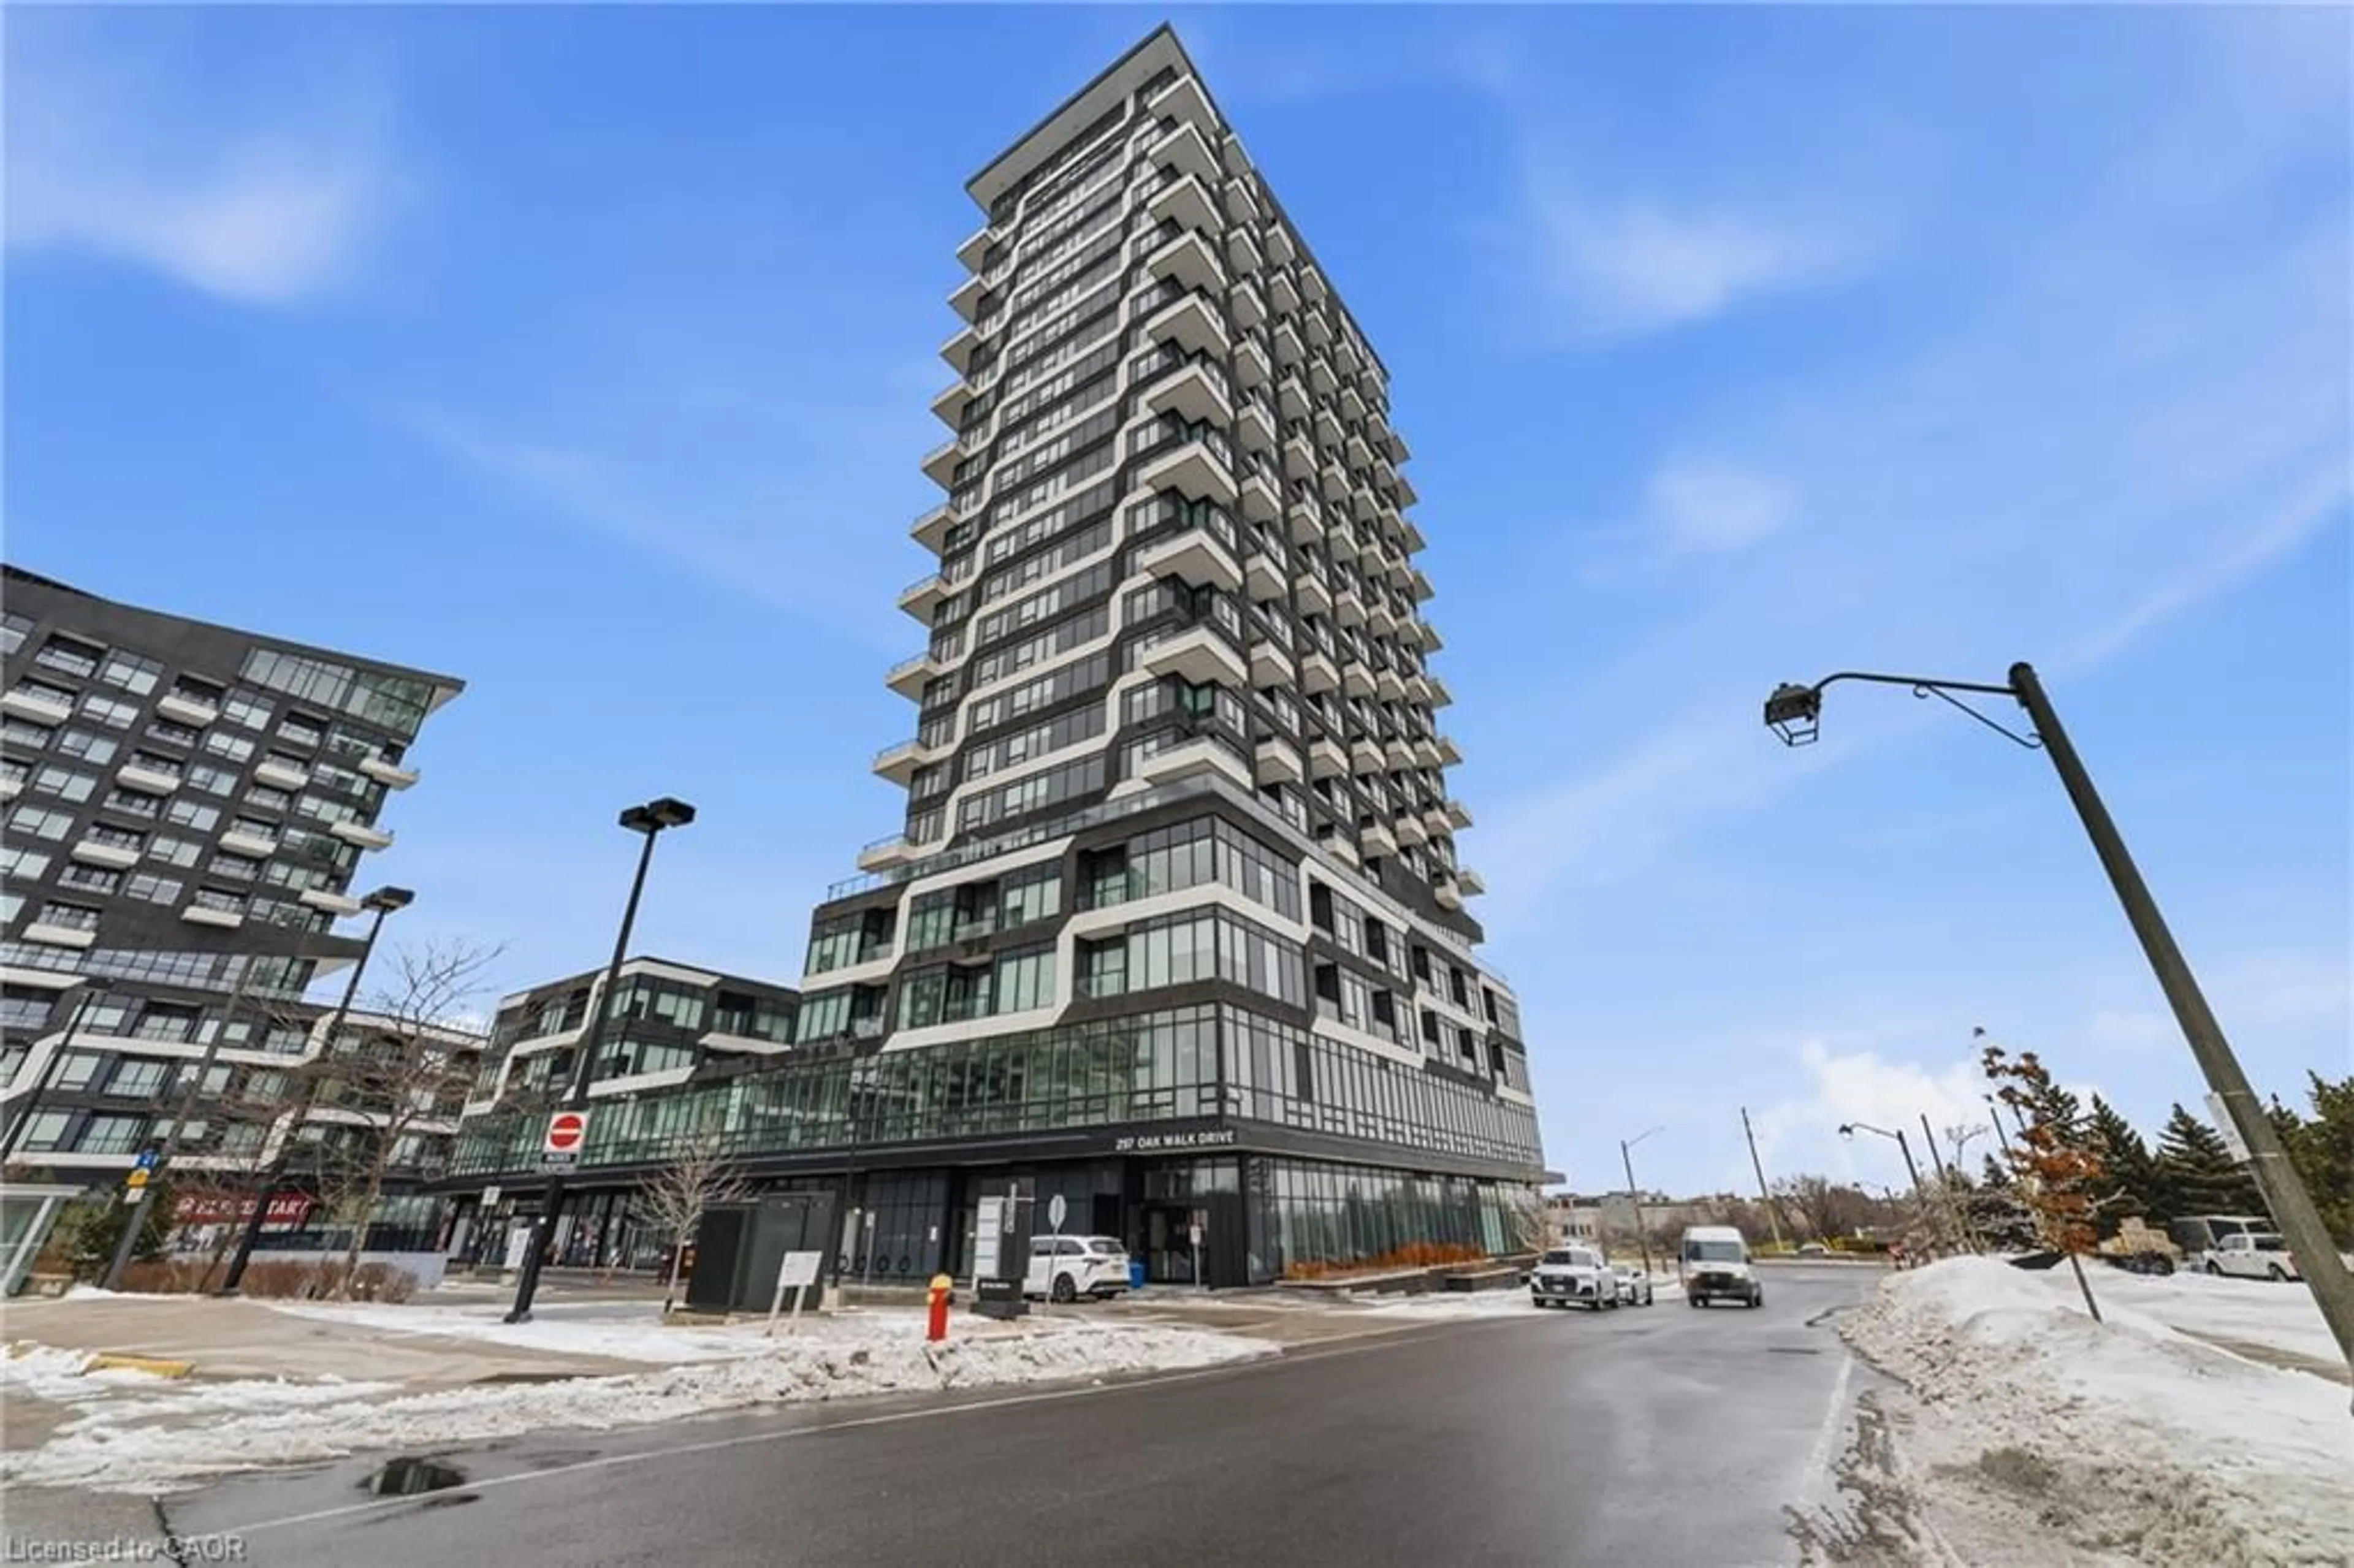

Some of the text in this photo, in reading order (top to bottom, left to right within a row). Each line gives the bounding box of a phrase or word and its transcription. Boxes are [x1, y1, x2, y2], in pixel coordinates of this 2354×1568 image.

[1137, 1136, 1160, 1149] OAK
[1164, 1134, 1195, 1146] WALK
[1198, 1130, 1233, 1145] DRIVE
